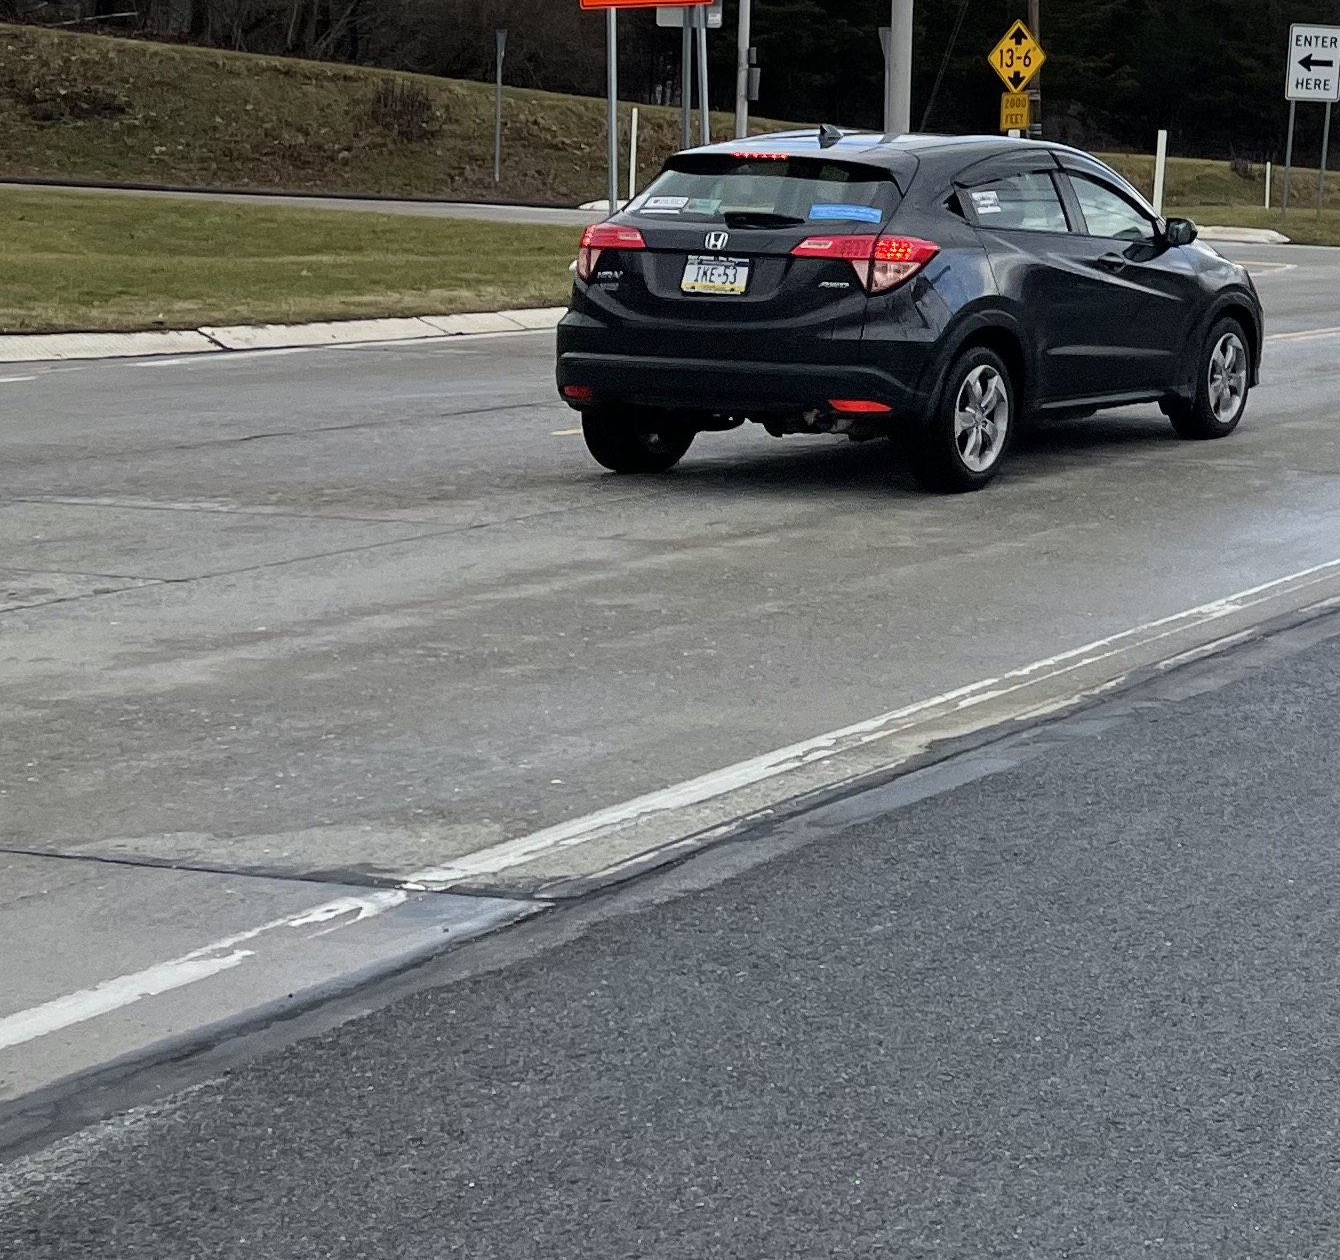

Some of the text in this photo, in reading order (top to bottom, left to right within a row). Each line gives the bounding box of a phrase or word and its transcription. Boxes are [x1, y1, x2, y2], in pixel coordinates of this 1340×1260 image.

[1295, 35, 1338, 49] ENTER
[1295, 77, 1331, 91] HERE
[1005, 98, 1026, 109] 2000
[1005, 113, 1024, 125] FEET
